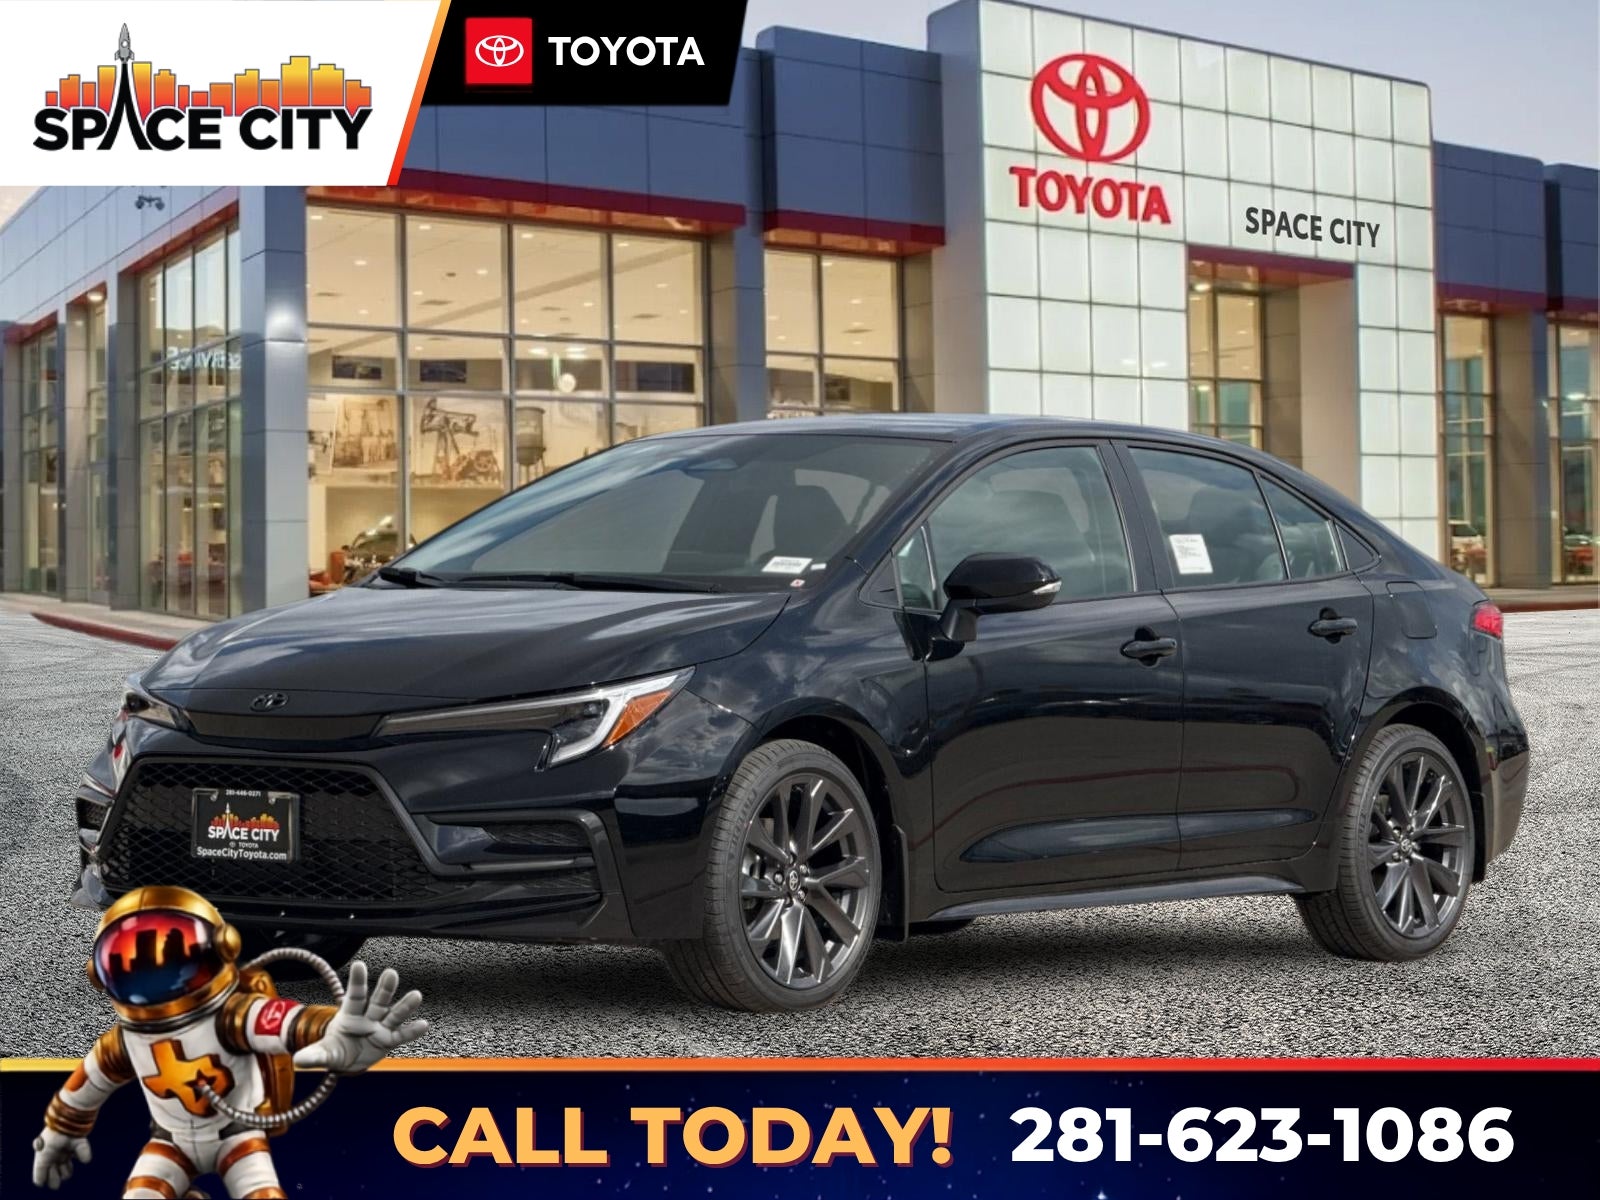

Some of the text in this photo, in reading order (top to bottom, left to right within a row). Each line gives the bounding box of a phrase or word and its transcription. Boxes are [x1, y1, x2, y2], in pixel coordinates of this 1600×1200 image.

[1009, 166, 1172, 225] TOYOTA
[1245, 206, 1381, 248] SPACE CITY
[207, 826, 280, 842] SPACE CITY
[196, 846, 287, 860] SpaceCityToyota.com
